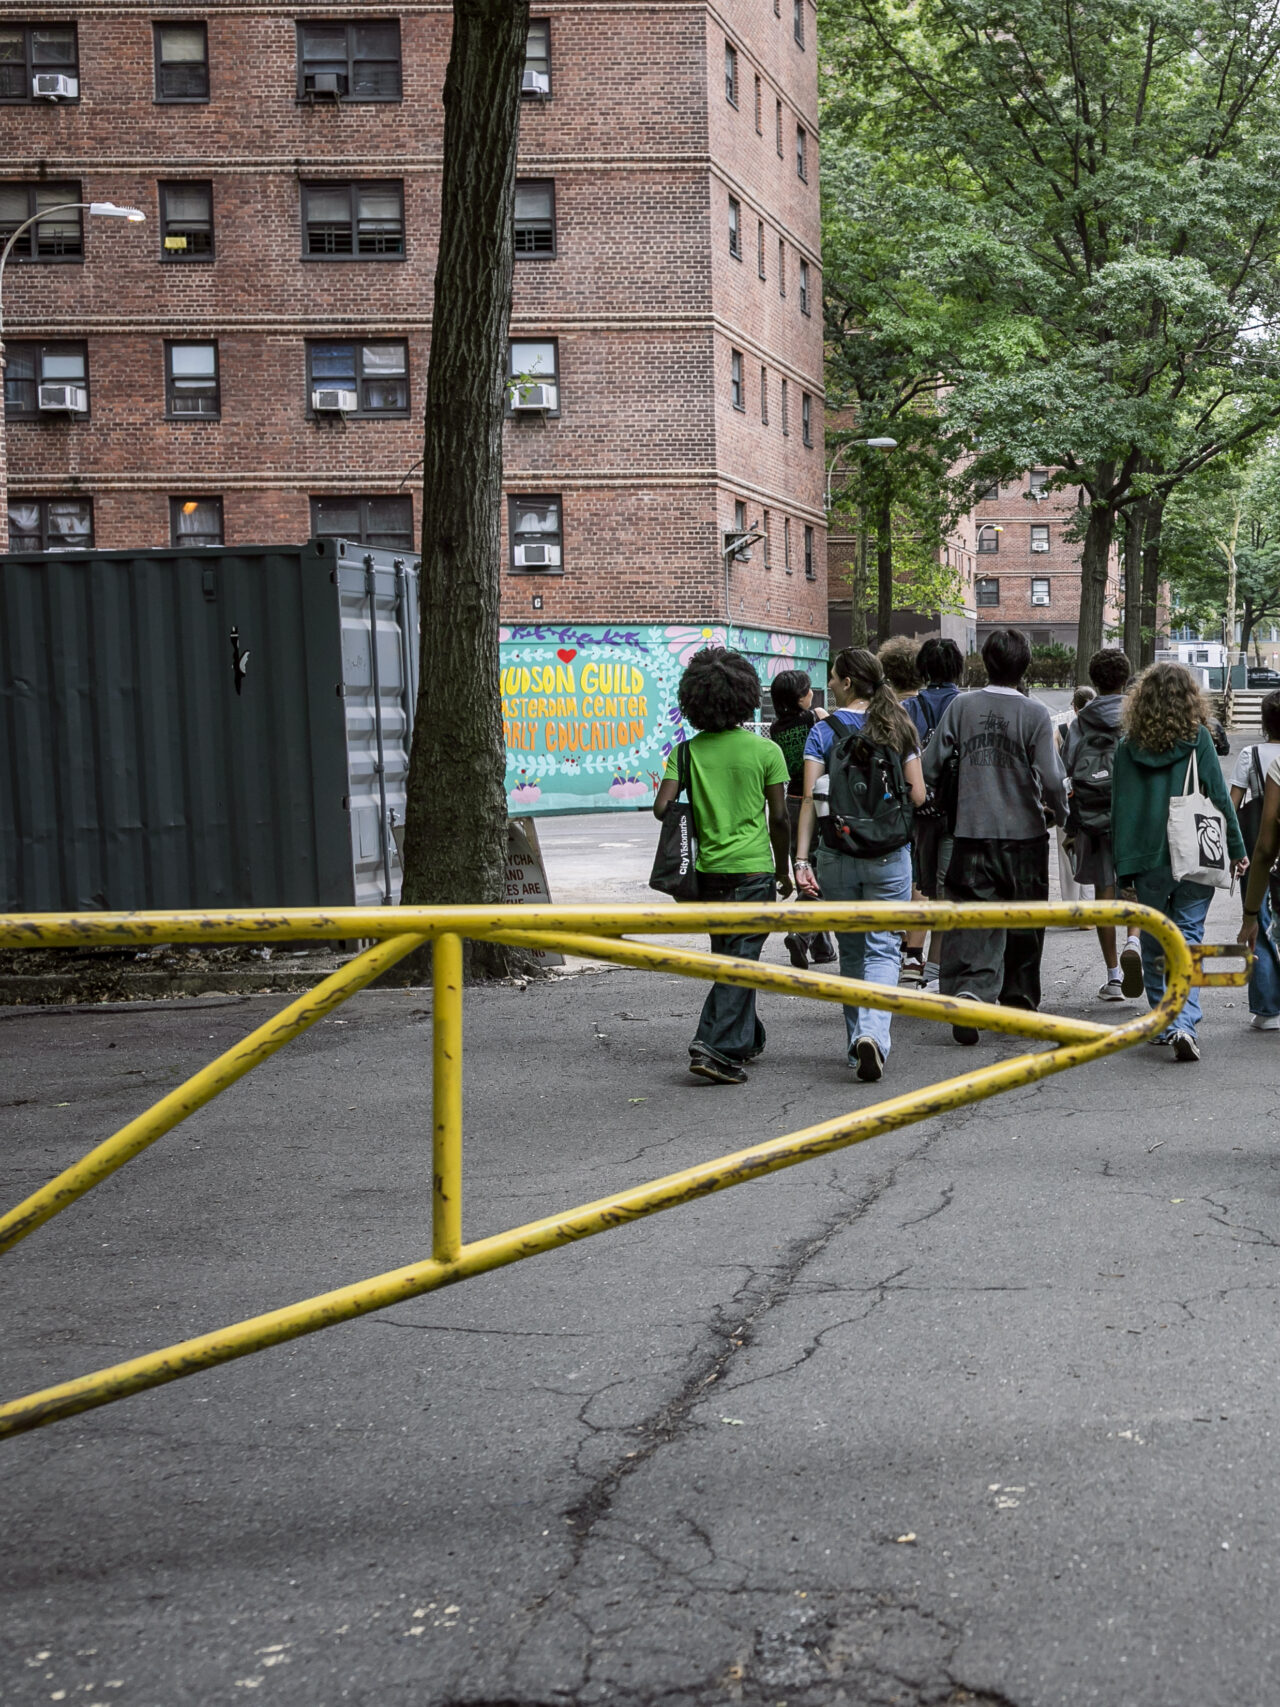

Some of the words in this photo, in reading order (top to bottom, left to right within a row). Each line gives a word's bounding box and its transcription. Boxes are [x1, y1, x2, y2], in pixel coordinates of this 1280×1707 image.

[580, 662, 644, 694] GUILD
[503, 720, 538, 750] ARLY
[679, 815, 688, 857] Visionaries
[506, 854, 534, 866] YCHA
[680, 857, 689, 875] City
[523, 883, 541, 895] ARE
